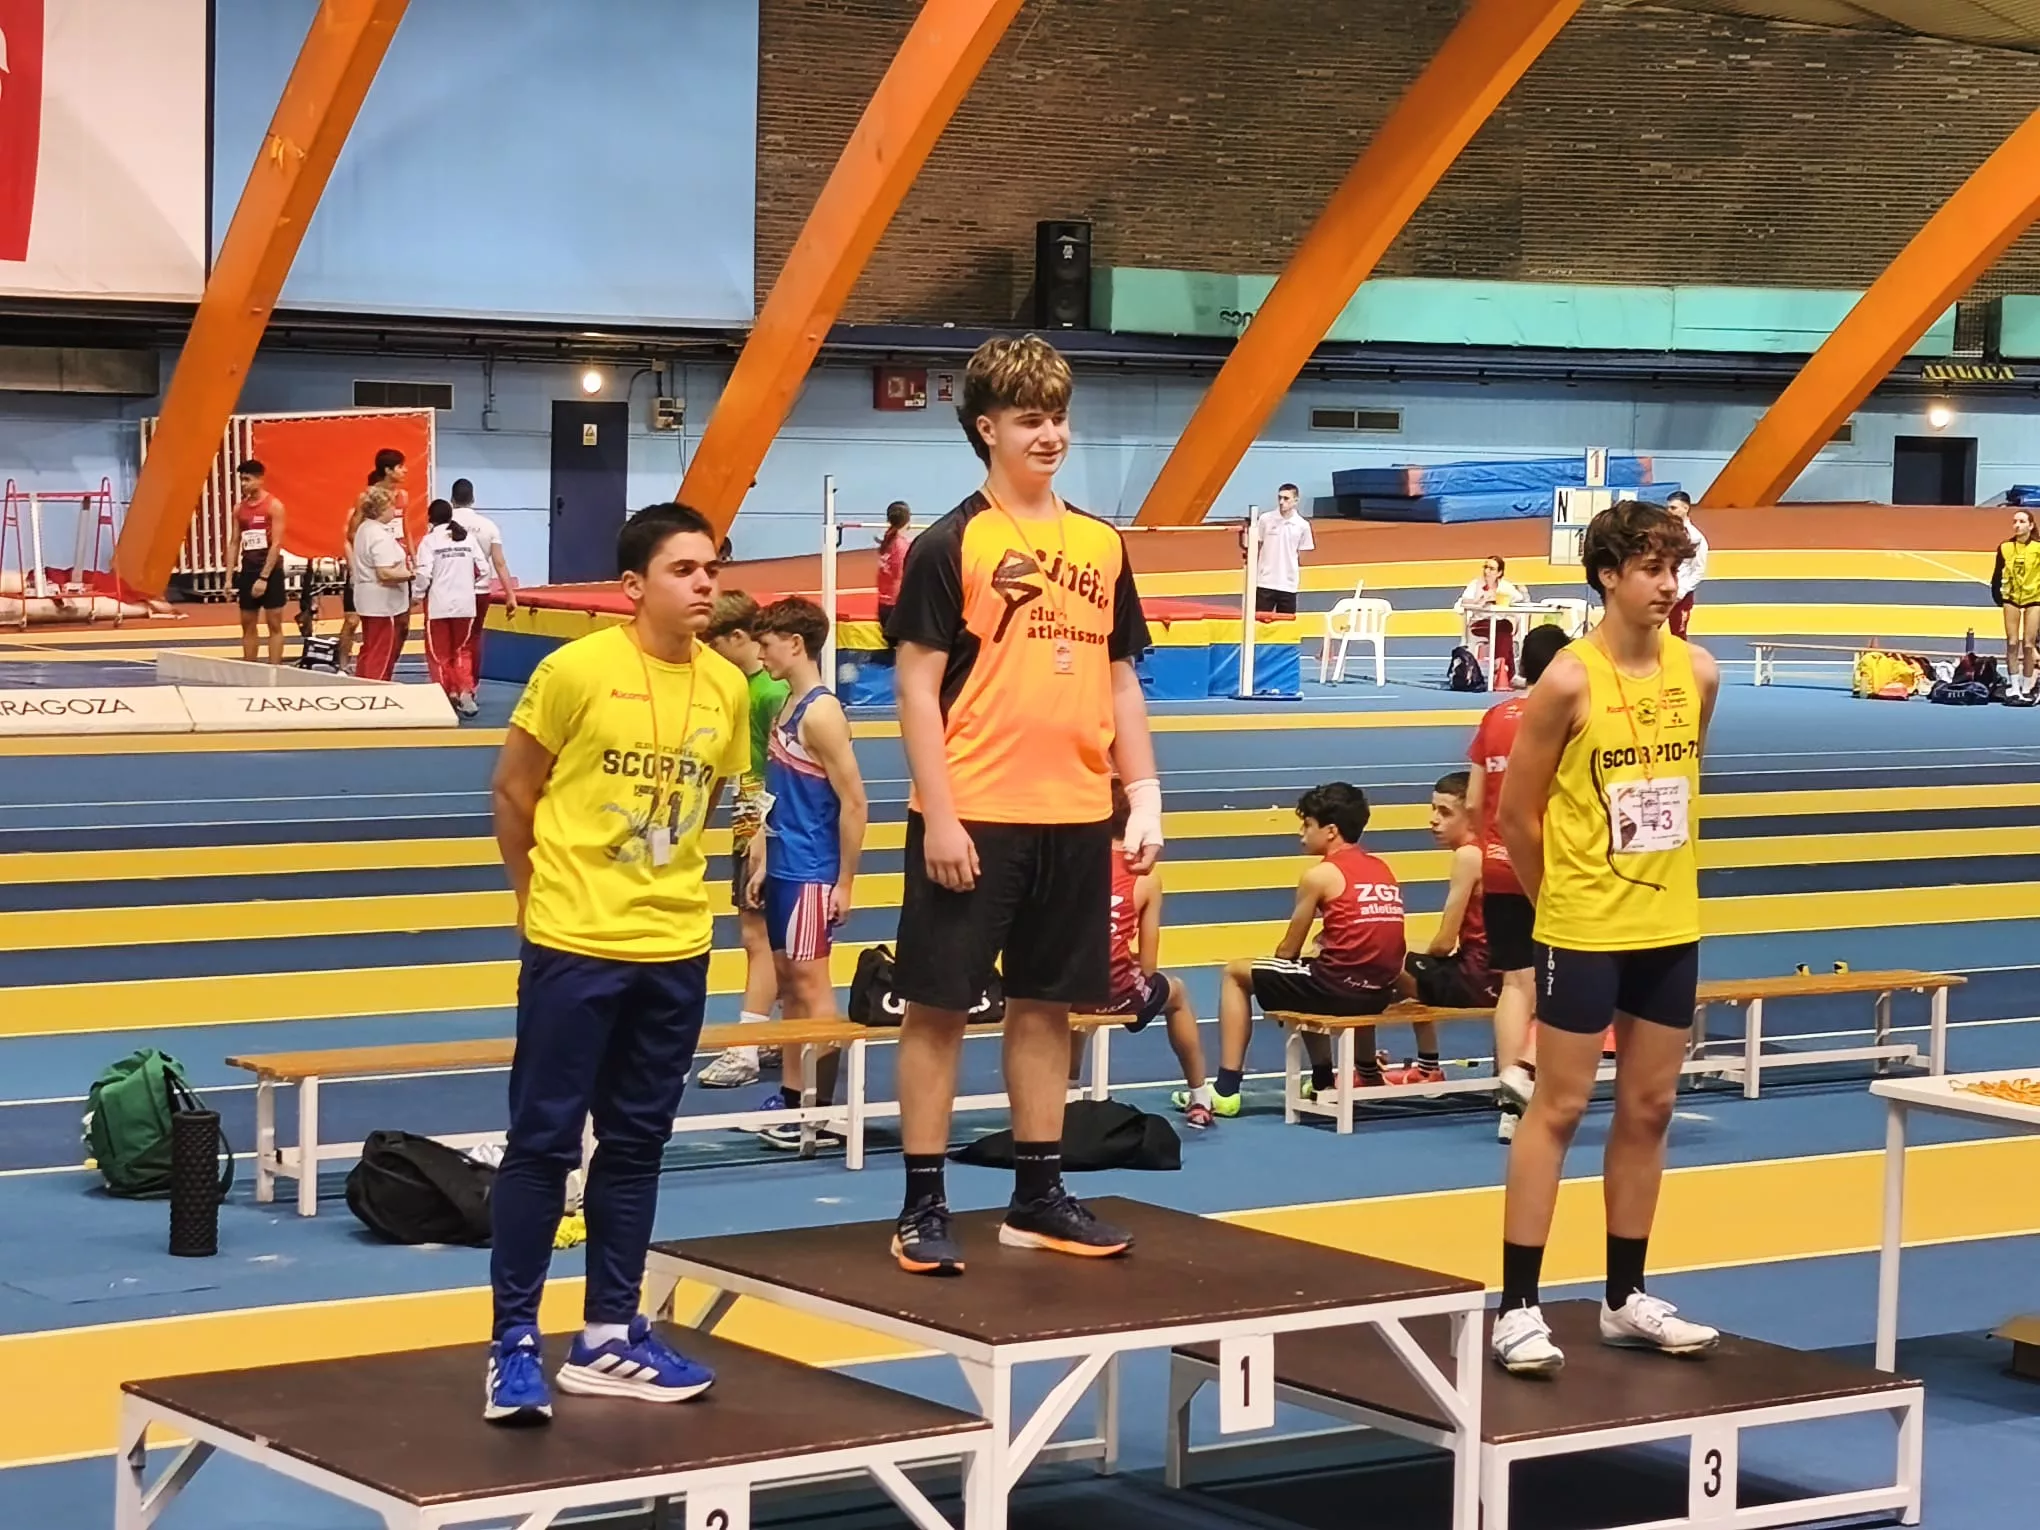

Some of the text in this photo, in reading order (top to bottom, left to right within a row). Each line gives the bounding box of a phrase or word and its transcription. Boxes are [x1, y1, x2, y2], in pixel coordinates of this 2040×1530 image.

[1590, 450, 1600, 478] 1
[1557, 490, 1569, 523] N
[1027, 624, 1105, 645] atletismo
[0, 698, 135, 716] RAGOZA
[238, 696, 404, 713] ZARAGOZA
[1240, 1355, 1250, 1407] 1
[1703, 1448, 1722, 1498] 3
